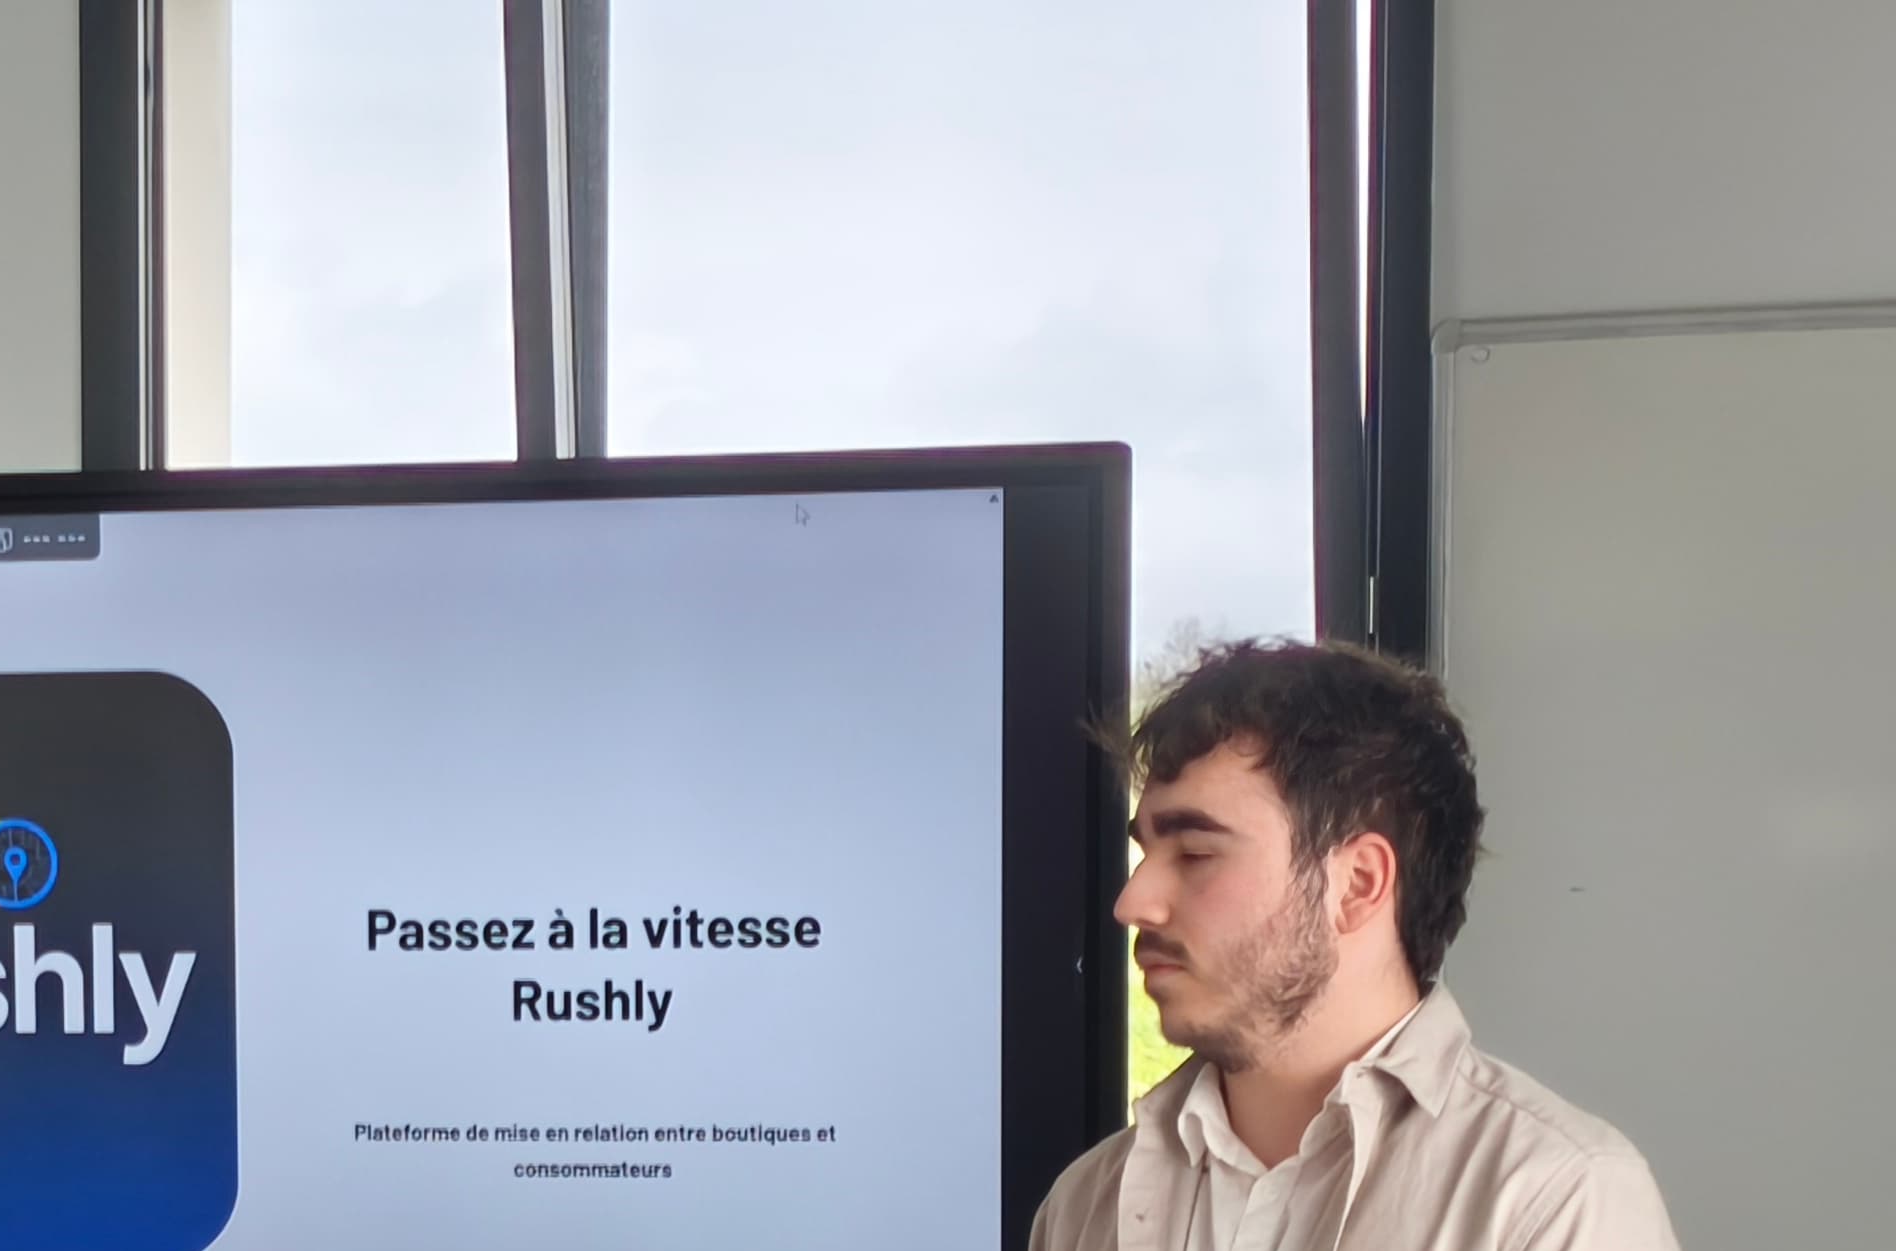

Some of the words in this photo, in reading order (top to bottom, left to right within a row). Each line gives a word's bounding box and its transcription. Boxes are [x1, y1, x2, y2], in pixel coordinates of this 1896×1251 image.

[367, 908, 535, 952] Passez
[548, 907, 575, 951] à
[588, 906, 629, 951] la
[641, 903, 822, 950] vitesse
[512, 978, 673, 1032] Rushly
[354, 1123, 461, 1143] Plateforme
[465, 1123, 490, 1143] de
[494, 1123, 541, 1143] mise
[545, 1127, 570, 1143] en
[573, 1123, 650, 1143] relation
[653, 1125, 707, 1143] entre
[711, 1123, 812, 1147] boutiques
[816, 1125, 836, 1143] et
[513, 1161, 673, 1180] consommateurs
